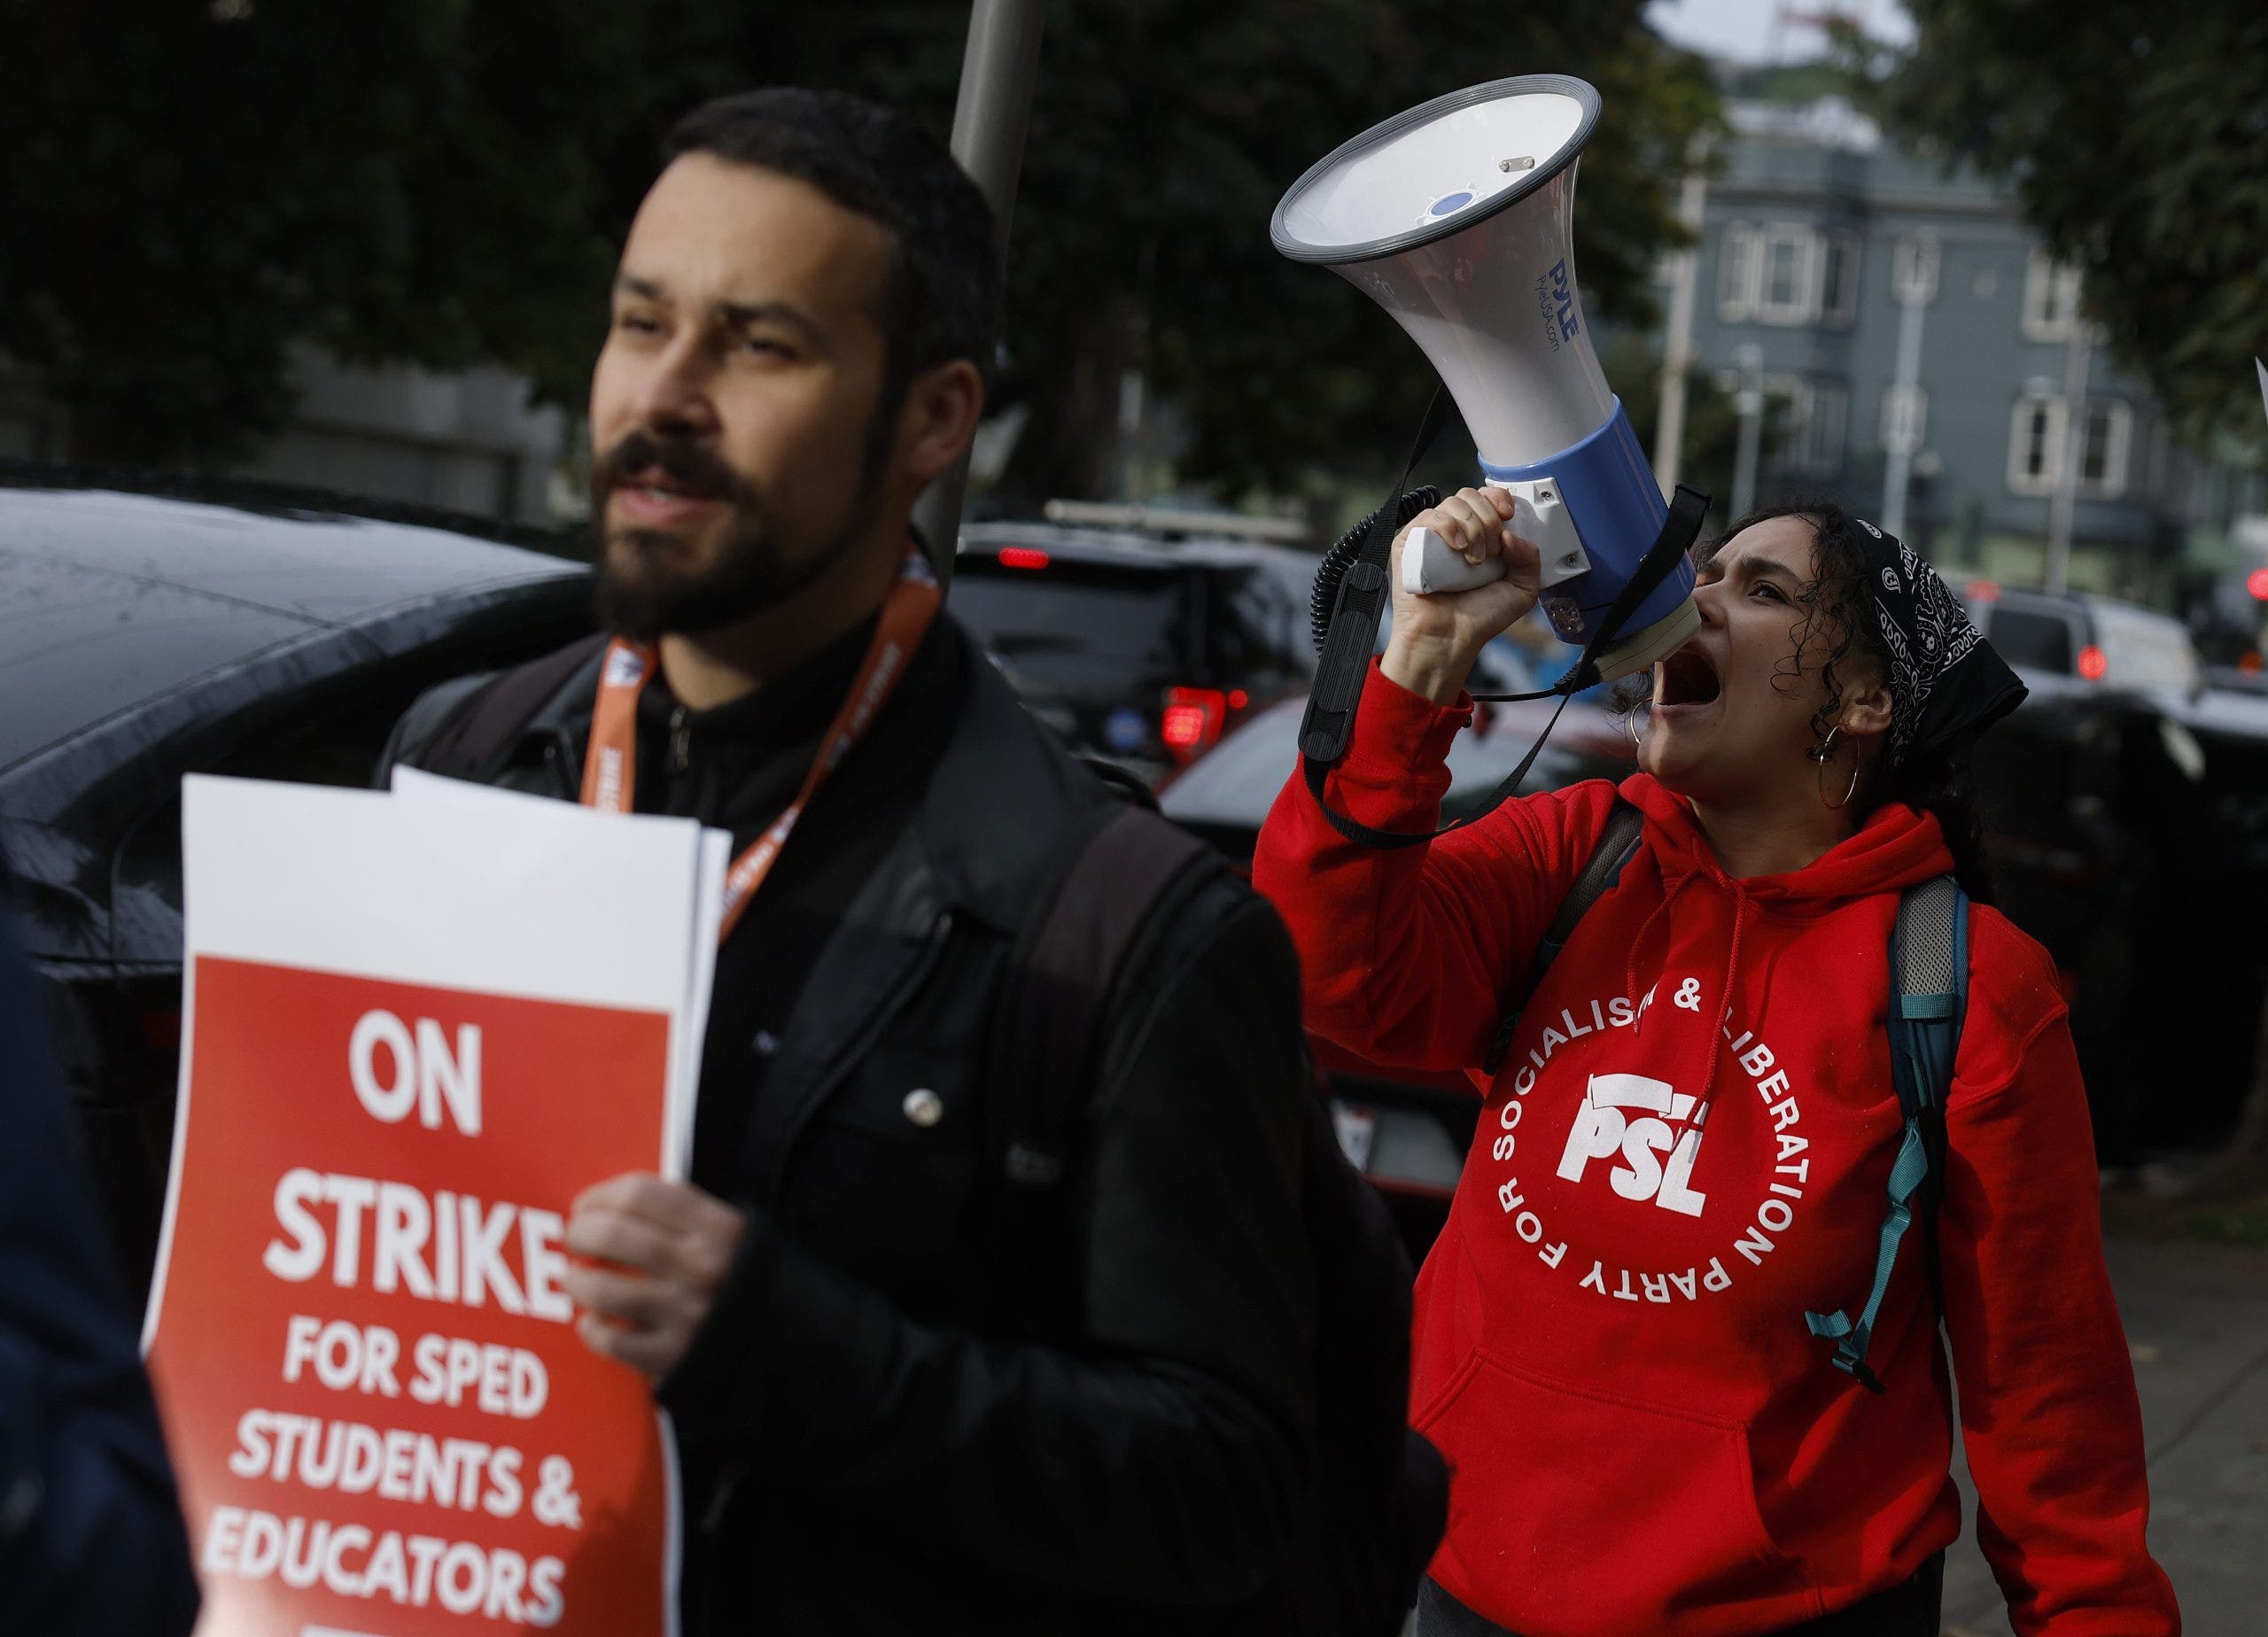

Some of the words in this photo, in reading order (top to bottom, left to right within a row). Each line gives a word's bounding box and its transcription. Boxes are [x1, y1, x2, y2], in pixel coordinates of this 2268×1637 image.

[1533, 275, 1559, 353] PyleUSA.com
[1674, 977, 1702, 1012] &
[348, 1010, 482, 1137] ON
[1557, 1095, 1707, 1218] PSL
[263, 1168, 575, 1323] STRIKE
[1498, 1176, 1568, 1270] FOR
[1580, 1257, 1733, 1304] PARTY
[282, 1315, 400, 1398] FOR
[409, 1333, 549, 1418] SPED
[228, 1408, 524, 1518] STUDENTS
[532, 1455, 582, 1530] &
[200, 1505, 565, 1628] EDUCATORS
